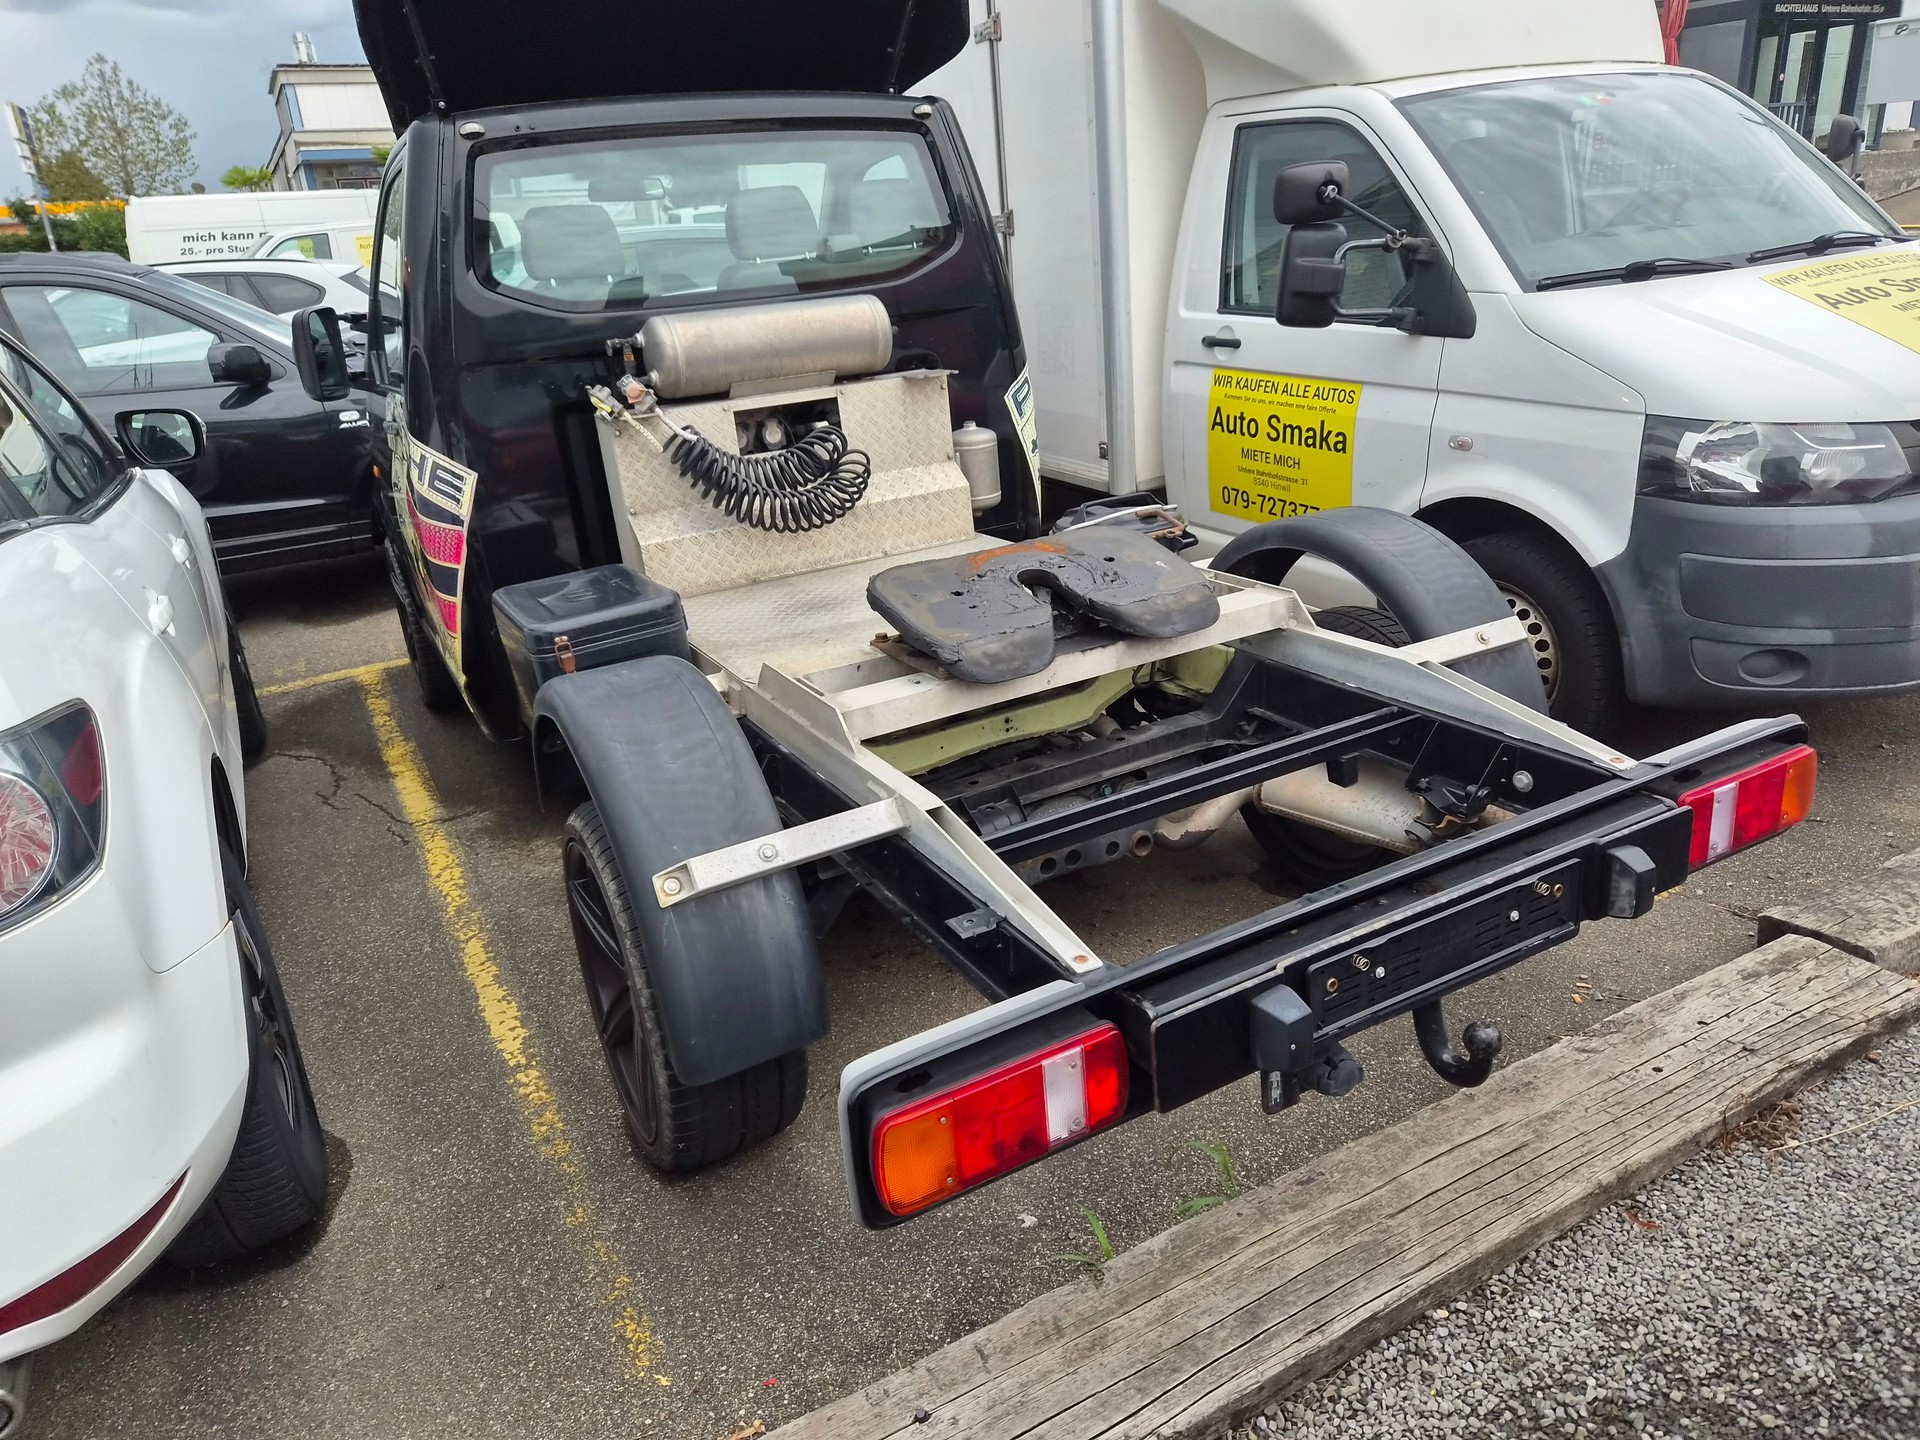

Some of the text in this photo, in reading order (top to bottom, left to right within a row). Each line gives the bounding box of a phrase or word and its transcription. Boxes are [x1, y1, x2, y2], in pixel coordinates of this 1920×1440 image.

[1775, 4, 1819, 12] BACHTELHAUS
[1822, 4, 1840, 12] Untere
[183, 232, 216, 242] mich
[222, 231, 254, 241] kann
[206, 247, 224, 256] pro
[1769, 273, 1803, 287] WIR
[1800, 263, 1855, 280] KAUFEN
[1854, 257, 1886, 270] ALLE
[1814, 286, 1892, 310] Auto
[1213, 374, 1356, 406] WIR KAUFEN ALLE AUTOS
[1224, 392, 1243, 402] Kommen
[1276, 400, 1295, 408] machen
[1306, 403, 1318, 412] faire
[1318, 406, 1337, 414] Offerte
[1211, 406, 1348, 454] Auto Smaka
[1241, 447, 1301, 470] MIETE MICH
[1238, 465, 1308, 486] Untere Bahnhofstrasse 31
[1253, 477, 1291, 492] 8340 Hinwil
